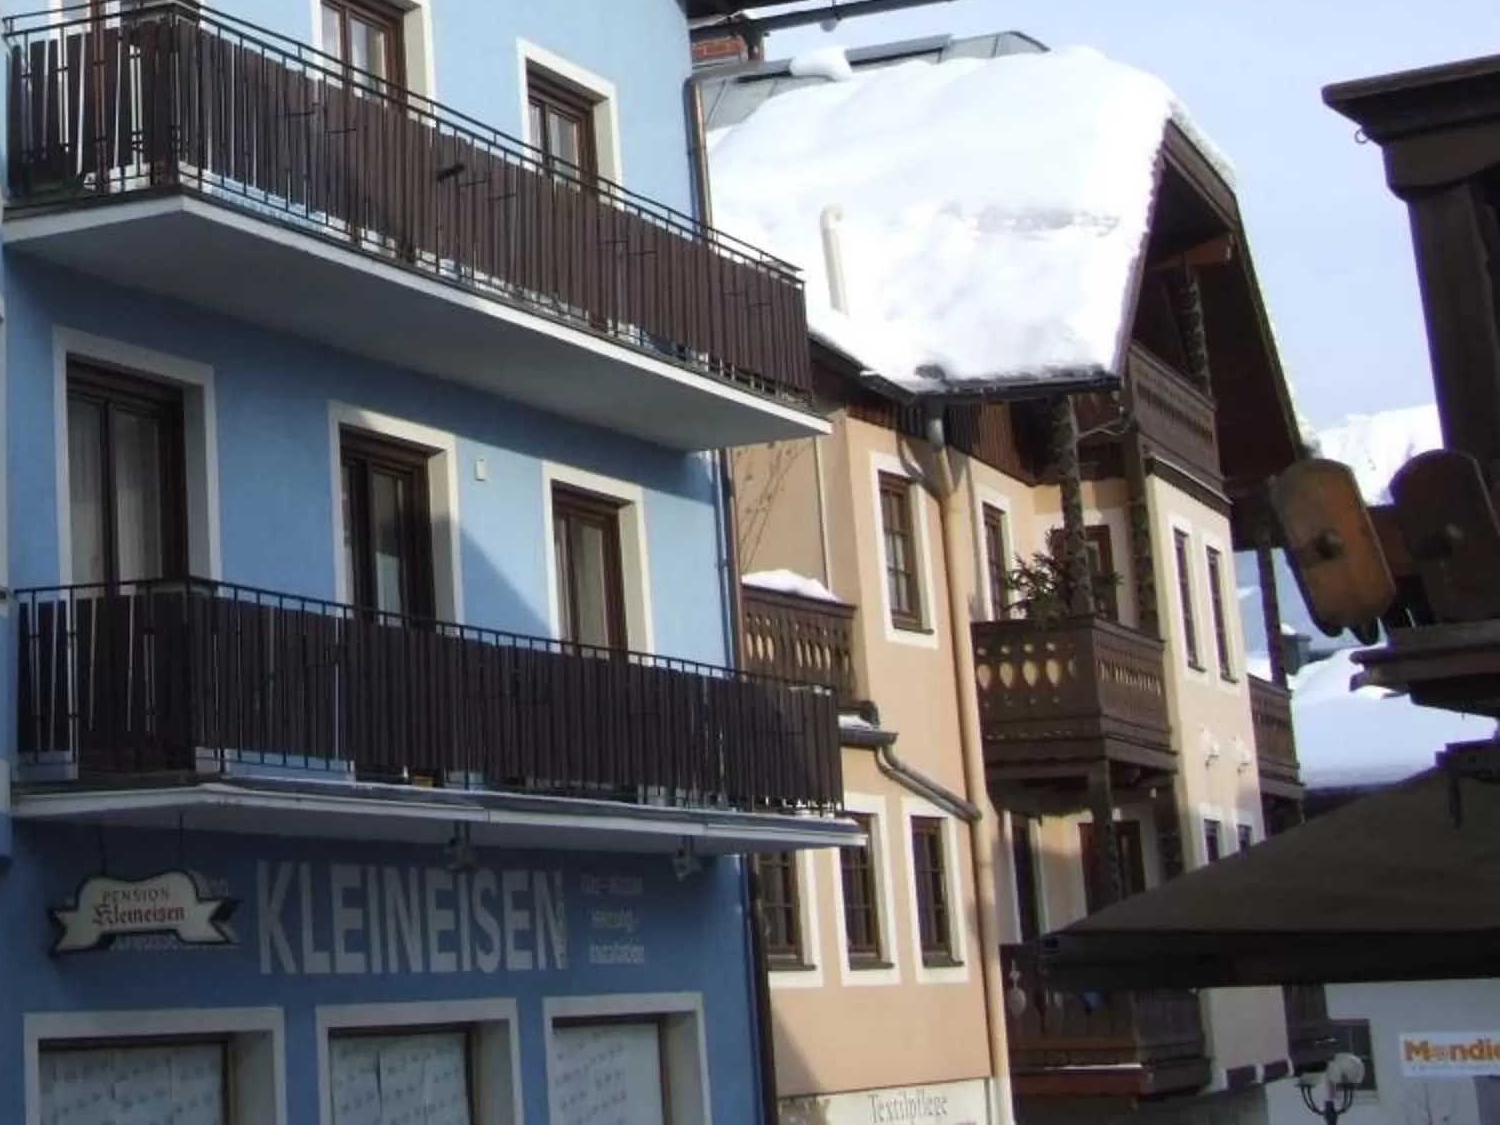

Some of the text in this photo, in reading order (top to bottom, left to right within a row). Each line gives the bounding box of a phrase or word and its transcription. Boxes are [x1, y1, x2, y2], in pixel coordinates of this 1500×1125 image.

[102, 886, 171, 904] PENSION
[92, 903, 185, 927] Kleineisen
[256, 859, 568, 975] KLEINEISEN
